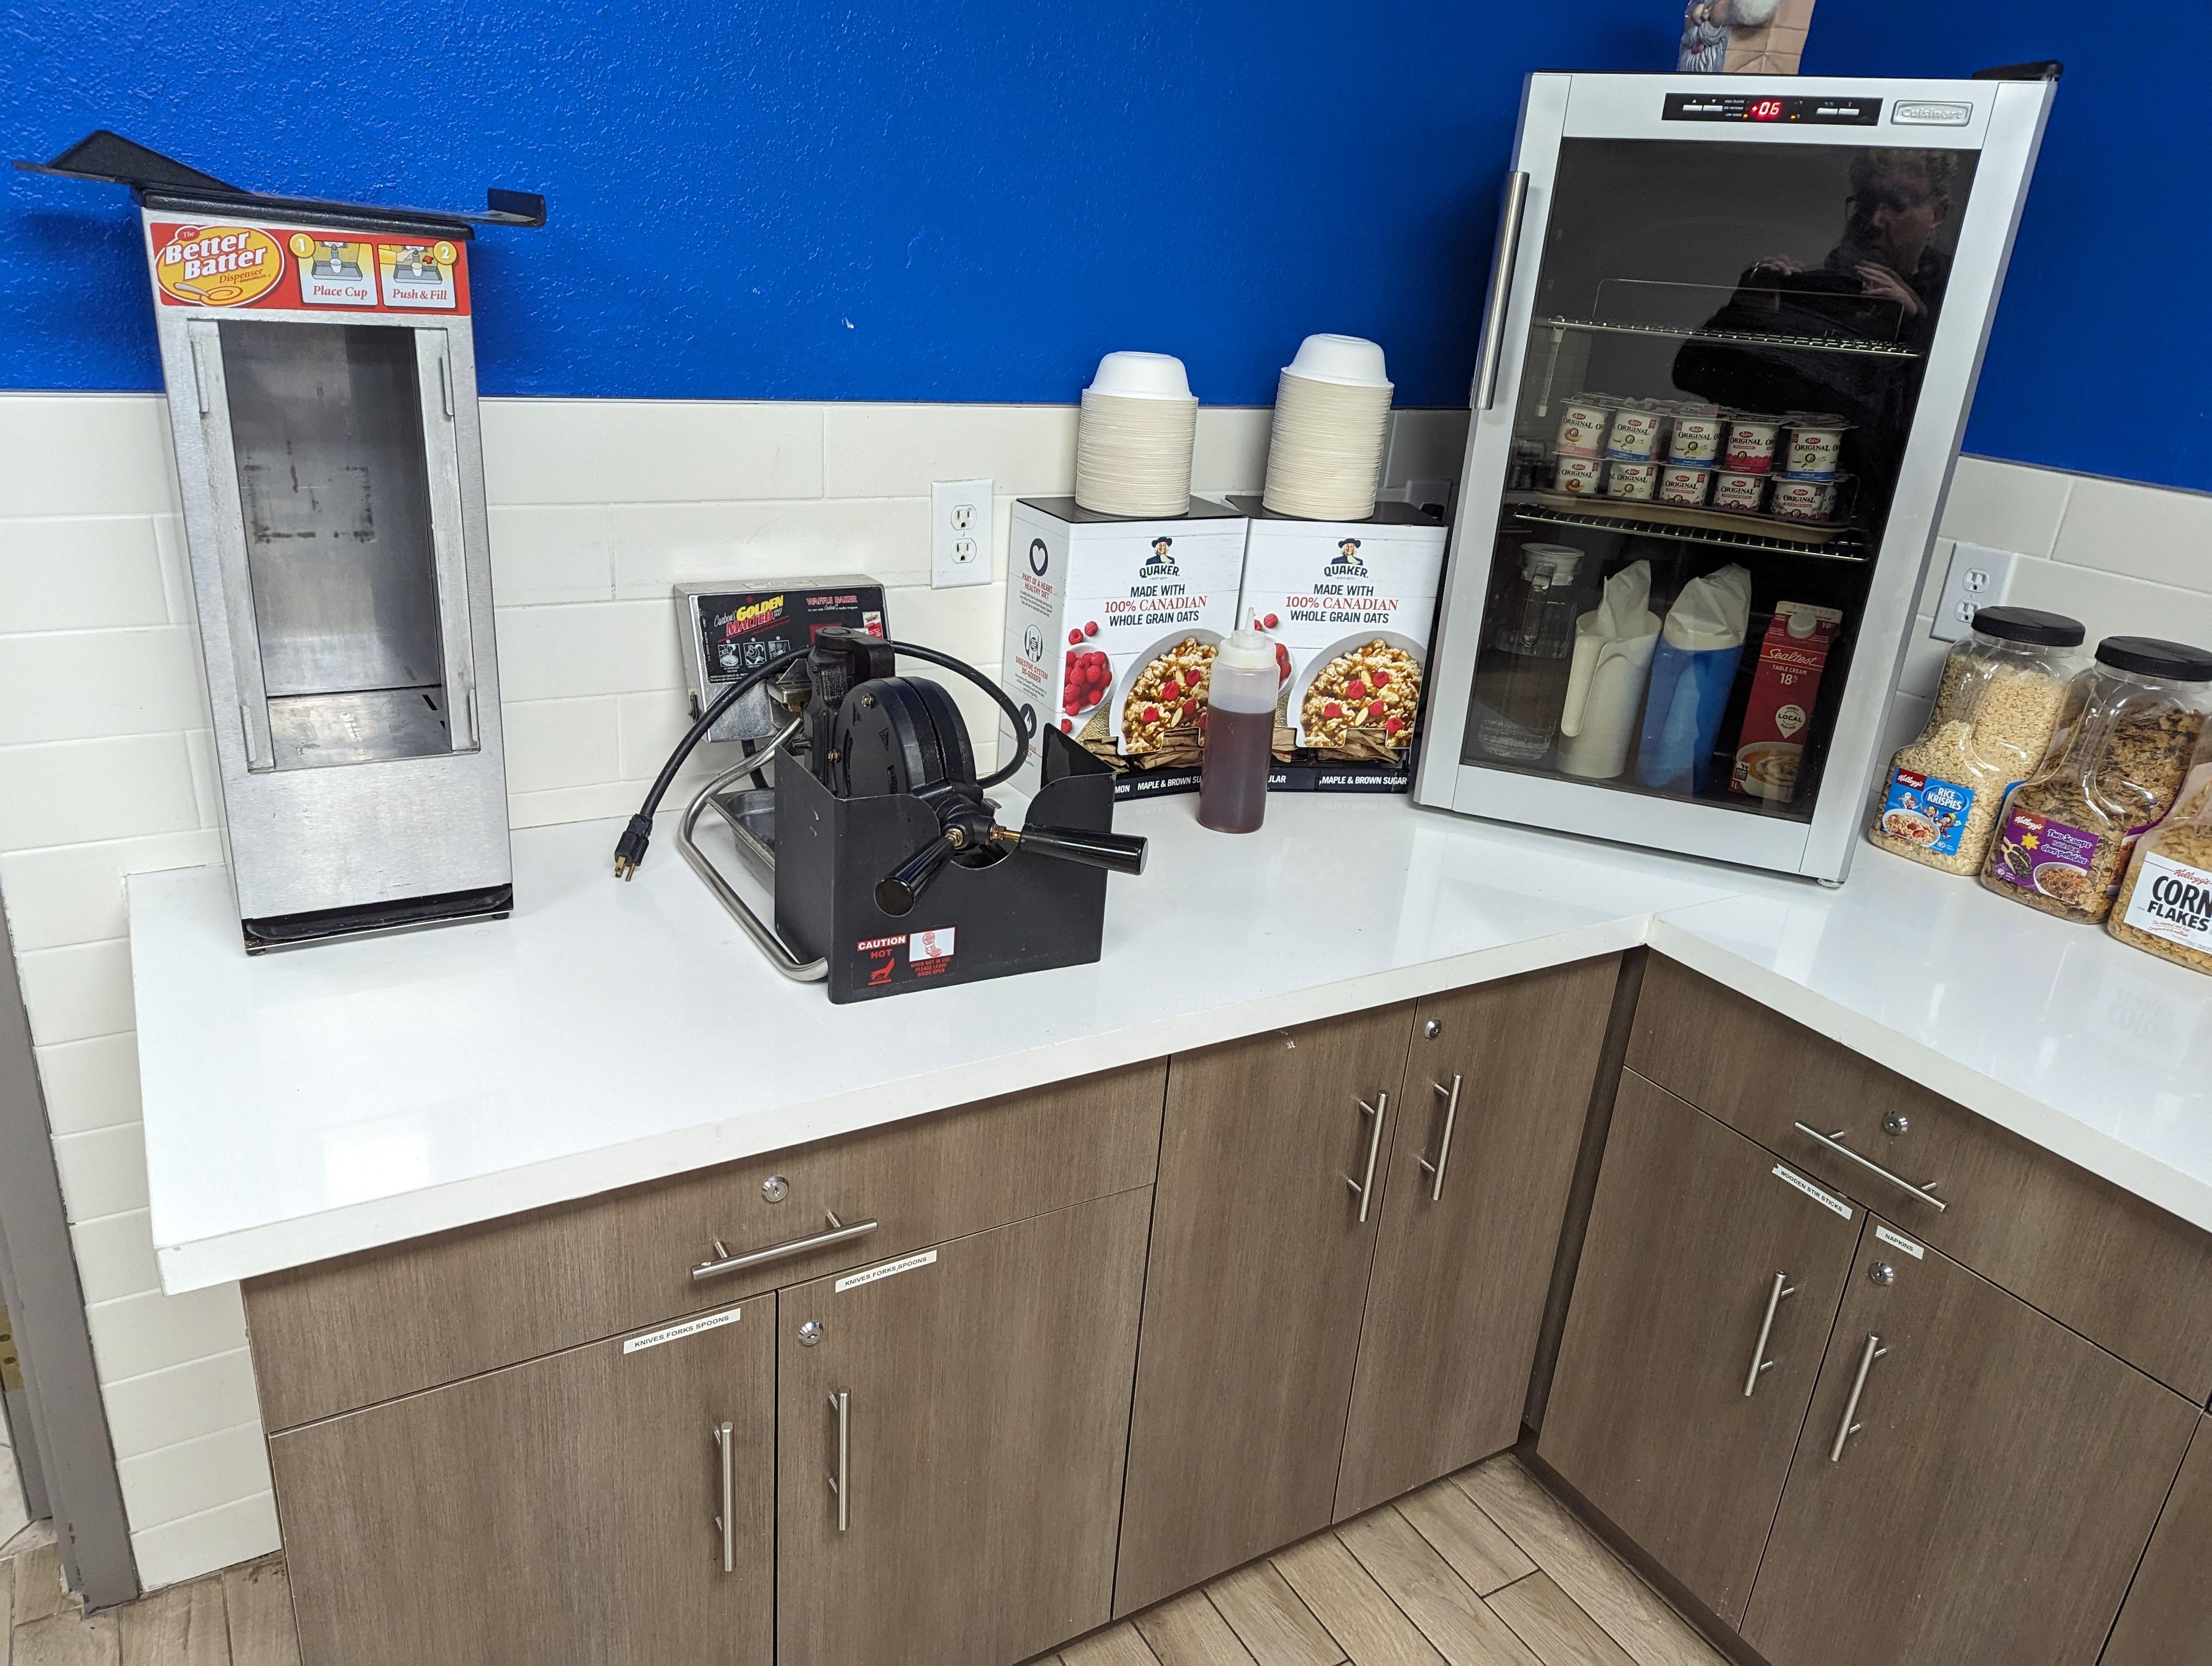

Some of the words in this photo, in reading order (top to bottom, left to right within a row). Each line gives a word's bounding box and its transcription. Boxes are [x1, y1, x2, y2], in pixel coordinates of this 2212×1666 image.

[1901, 107, 1963, 119] Cuisinart
[165, 230, 250, 265] Better
[298, 238, 305, 252] 1
[440, 246, 450, 259] 2
[184, 247, 267, 281] Batter
[219, 268, 263, 284] Dispenser
[313, 285, 342, 297] Place
[345, 286, 368, 299] Cup
[393, 289, 418, 299] Push
[420, 291, 428, 299] &
[430, 290, 447, 300] Fill
[1139, 565, 1180, 579] QUAKER
[1323, 565, 1369, 579] QUAKER
[1021, 573, 1032, 583] PART
[1041, 581, 1053, 593] HEART
[1313, 584, 1344, 595] MADE
[1347, 585, 1374, 597] WITH
[1025, 582, 1041, 595] HEALTHY
[1041, 590, 1050, 600] DIET
[1130, 586, 1158, 598] MADE
[1161, 584, 1186, 596] WITH
[736, 594, 784, 621] GOLDEN
[806, 596, 833, 606] WAFFLE
[834, 595, 858, 604] BAKER
[1104, 600, 1136, 613] 100%
[1139, 595, 1208, 611] CANADIAN
[1285, 596, 1320, 609] 100%
[1323, 597, 1400, 611] CANADIAN
[713, 610, 736, 627] Carbon's
[725, 610, 774, 637] MALTED
[1109, 614, 1143, 626] WHOLE
[1146, 612, 1174, 624] GRAIN
[1176, 610, 1200, 623] OATS
[1290, 610, 1327, 621] WHOLE
[1329, 611, 1361, 623] GRAIN
[1363, 613, 1390, 624] OATS
[1770, 648, 1817, 665] Sealtest
[1015, 656, 1034, 671] DIGESTIVE
[1033, 666, 1048, 680] SYSTEM
[1021, 667, 1041, 684] DO-GOODER
[1789, 667, 1808, 676] CREAM
[1778, 713, 1803, 722] LOCAL
[1137, 780, 1160, 791] MAPLE
[1160, 780, 1166, 788] &
[1167, 777, 1192, 787] BROWN
[1321, 776, 1347, 785] MAPLE
[1347, 776, 1354, 785] &
[1355, 776, 1382, 785] BROWN
[1382, 777, 1407, 785] SUGAR
[1897, 774, 1924, 787] Kellogg's
[1937, 786, 1957, 800] RICE
[1926, 792, 1963, 811] KRISPIES
[2014, 816, 2044, 830] Kellogg's
[2047, 829, 2064, 840] Two
[2063, 834, 2092, 849] Scoops
[2041, 844, 2057, 854] deux
[2056, 849, 2088, 864] pelletées
[2052, 840, 2068, 850] Raisin
[2068, 845, 2081, 854] Bran
[2174, 869, 2211, 885] Kellogg's
[2152, 875, 2212, 919] CORN
[2146, 900, 2210, 932] FLAKES
[858, 935, 906, 950] CAUTION
[870, 949, 892, 959] HOT
[1780, 1170, 1807, 1190] WOODEN
[1806, 1186, 1821, 1199] STIR
[1821, 1195, 1843, 1213] STICKS
[1885, 1233, 1914, 1252] NAPKINS
[897, 1257, 927, 1269] SPOONS
[695, 1315, 730, 1330] SPOONS
